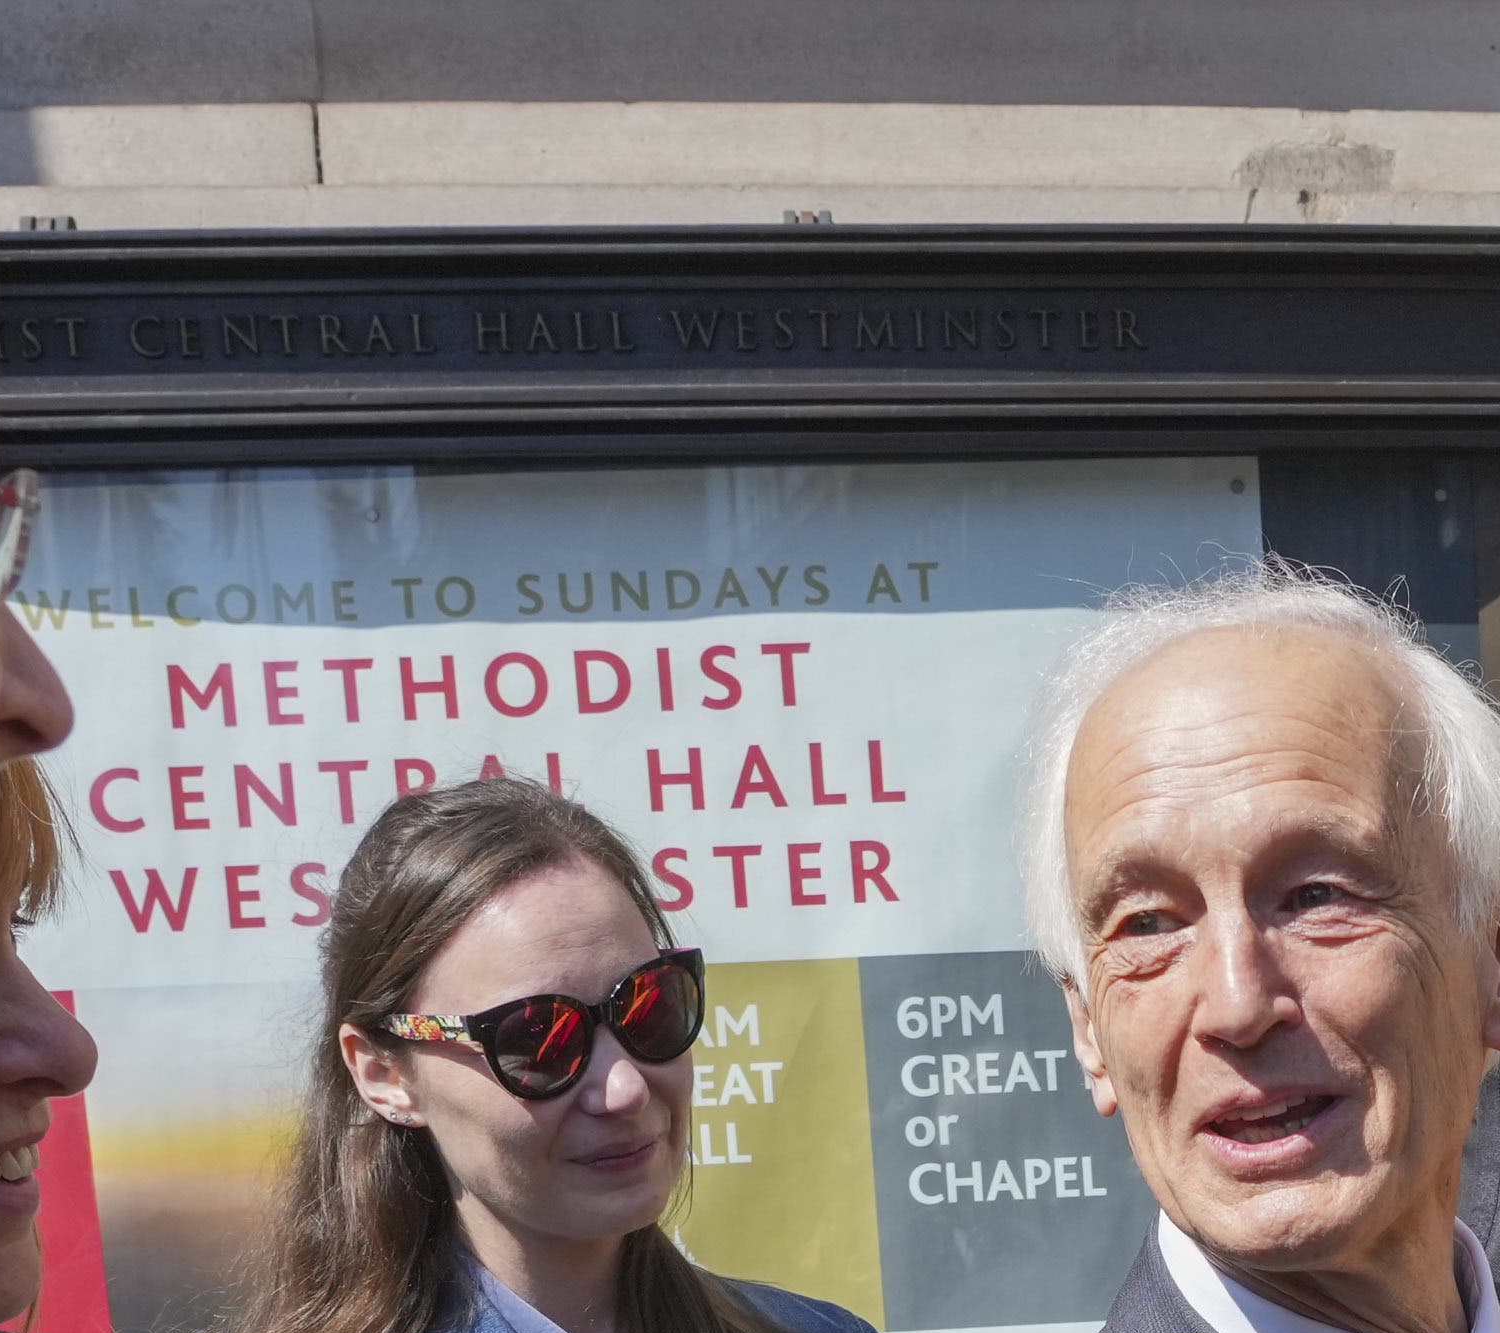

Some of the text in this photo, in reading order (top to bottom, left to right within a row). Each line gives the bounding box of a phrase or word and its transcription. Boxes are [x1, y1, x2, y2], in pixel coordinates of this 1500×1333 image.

[129, 312, 436, 359] CENTRAL
[475, 310, 635, 354] HALL
[669, 307, 1149, 352] WESTMINSTER
[15, 561, 940, 631] WELCOME TO SUNDAYS AT
[166, 642, 812, 729] METHODIST
[646, 739, 907, 812] HALL
[108, 839, 901, 933] WESSTER
[896, 993, 1005, 1041] 6PM
[693, 1061, 784, 1107] EAT
[900, 1049, 1067, 1098] GREAT
[904, 1113, 960, 1149] or
[908, 1155, 1108, 1206] CHAPEL
